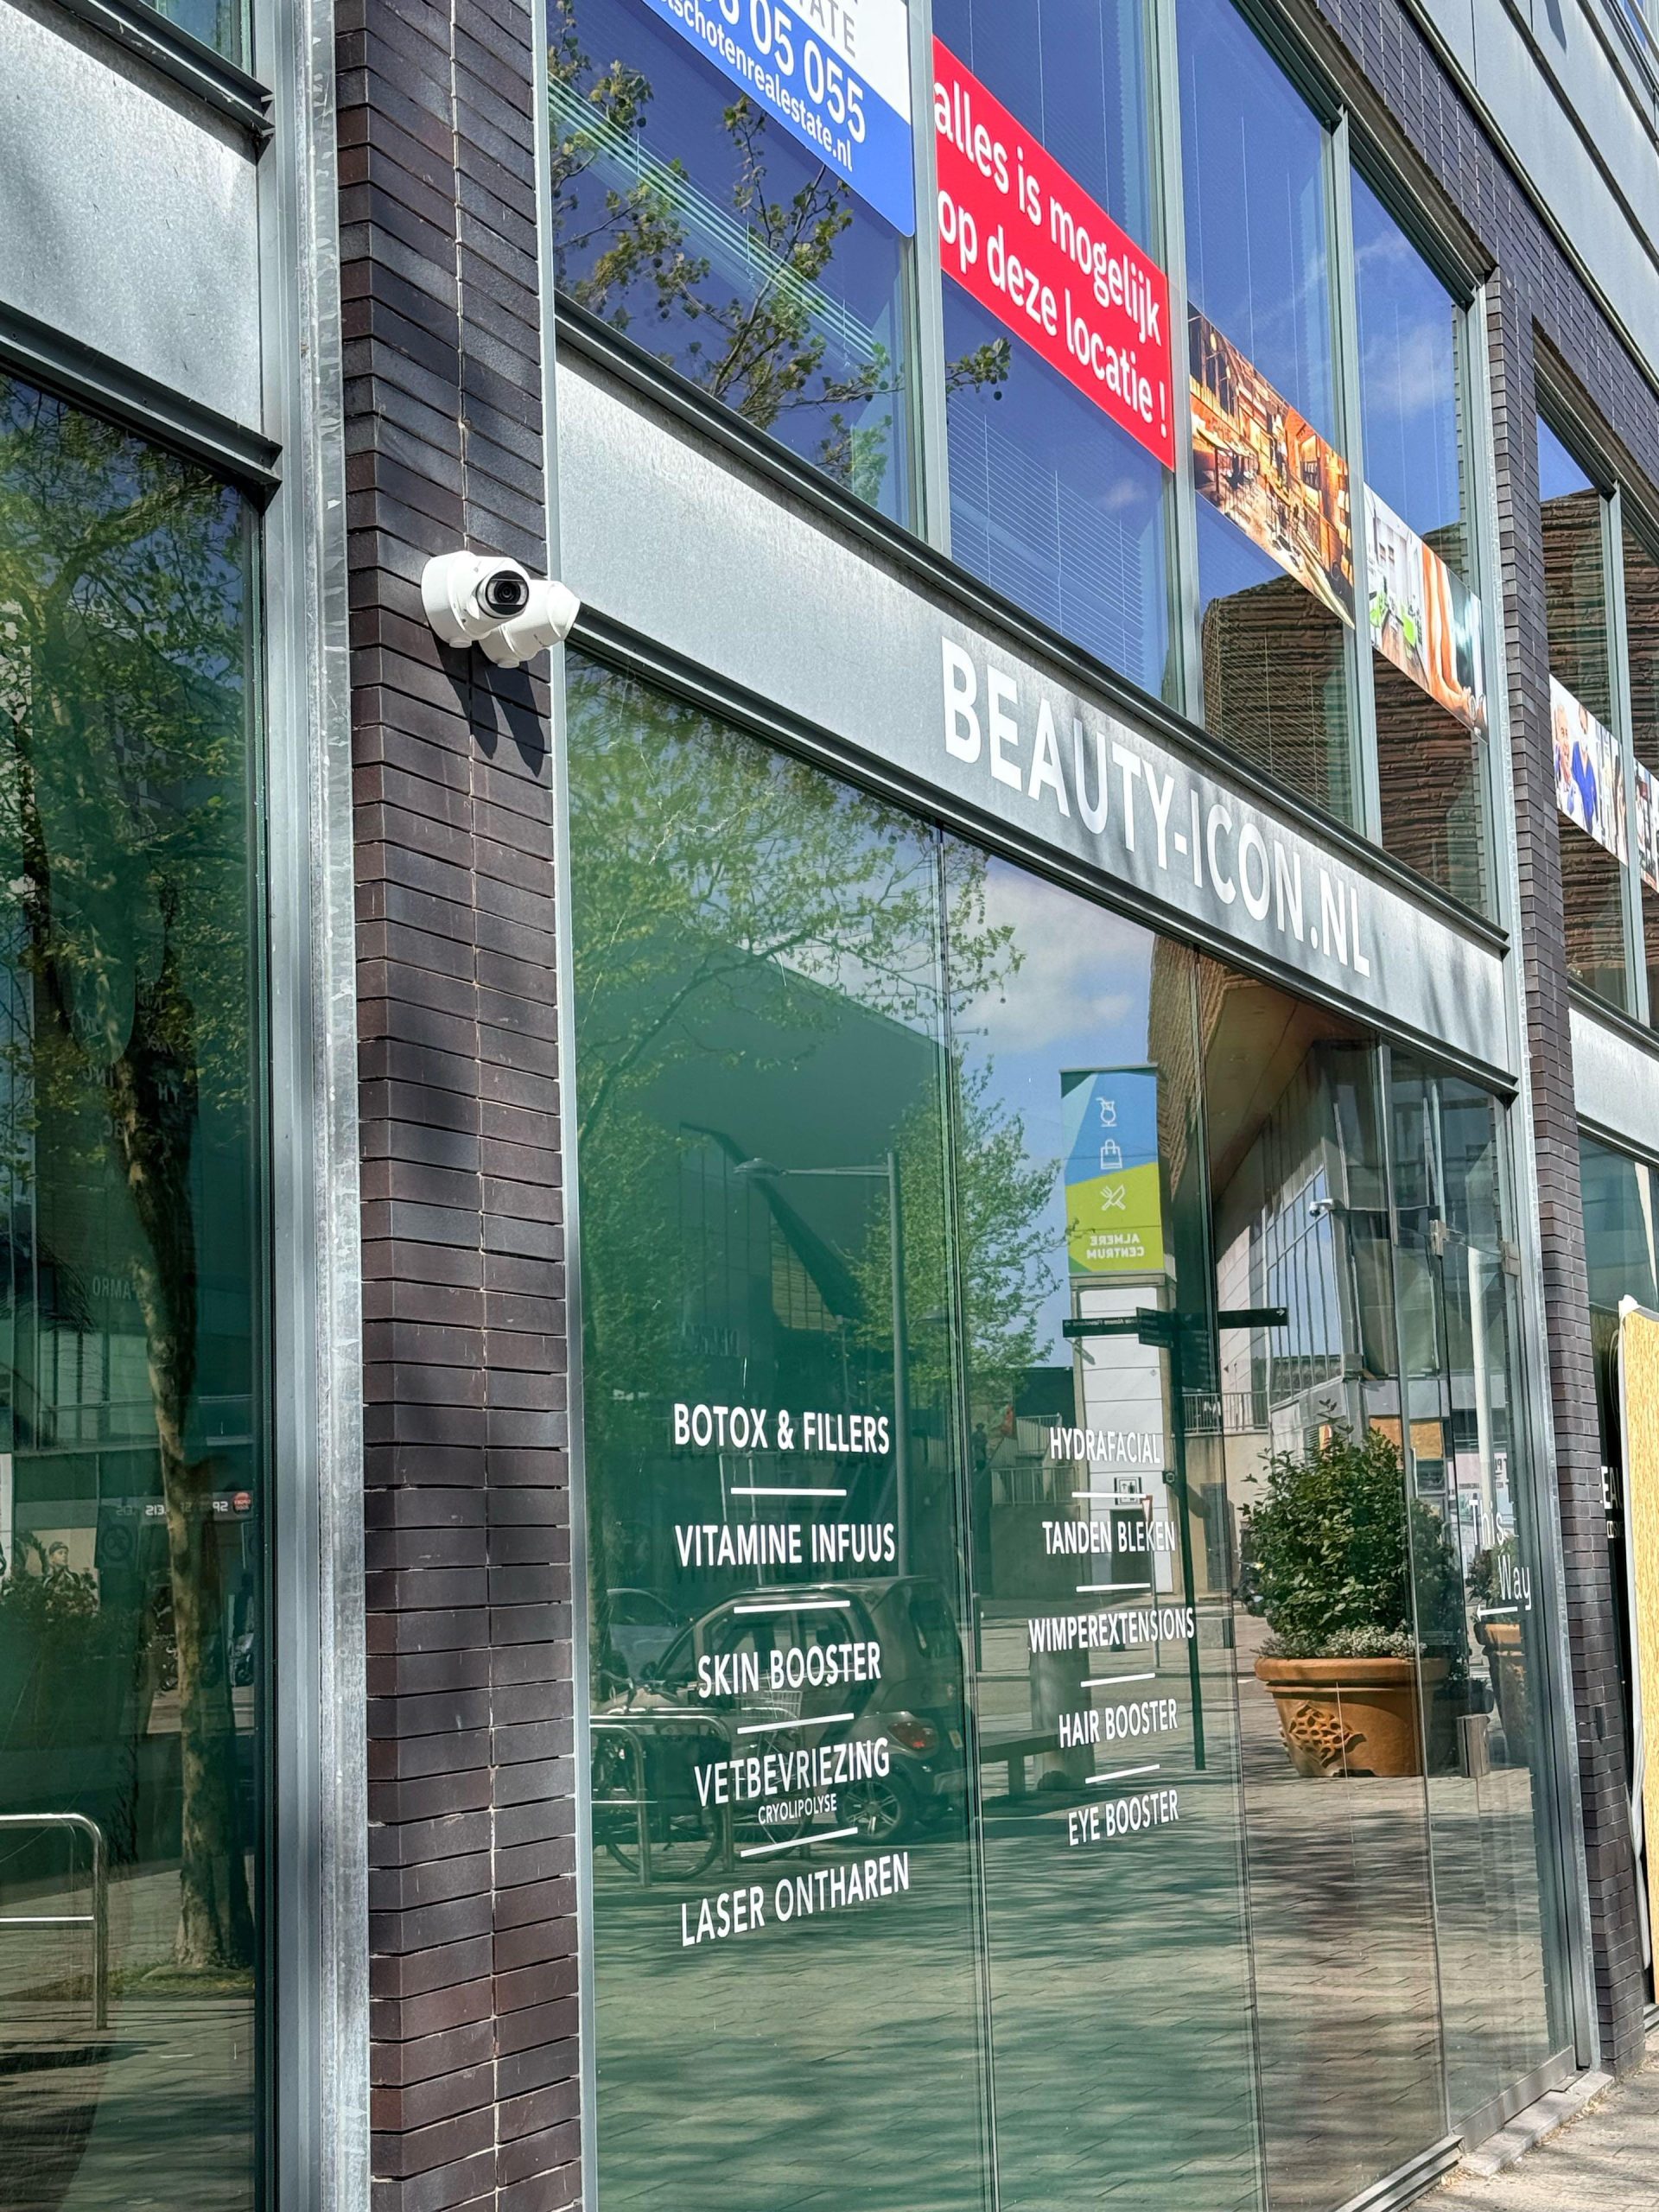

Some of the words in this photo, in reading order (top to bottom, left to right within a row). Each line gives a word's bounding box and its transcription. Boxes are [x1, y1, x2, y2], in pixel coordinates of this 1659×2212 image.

[660, 0, 853, 171] schotenrealestate.nl
[750, 0, 794, 76] 05
[804, 40, 866, 143] 055
[934, 81, 1009, 194] alles
[1018, 147, 1042, 226] is
[1051, 197, 1162, 346] mogelijk
[938, 194, 978, 273] op
[987, 226, 1058, 336] deze
[1065, 289, 1154, 423] locatie
[941, 636, 1370, 978] BEAUTY-ICON.NL
[674, 1403, 768, 1448] BOTOX
[778, 1409, 794, 1450] &
[803, 1412, 889, 1454] FILLERS
[1050, 1427, 1161, 1464] HYDRAFACIAL
[675, 1524, 802, 1567] VITAMINE
[812, 1523, 895, 1562] INFUUS
[1042, 1521, 1112, 1554] TANDEN
[1117, 1521, 1176, 1552] BLEKEN
[1469, 1499, 1505, 1546] This
[1498, 1554, 1531, 1611] Way
[1028, 1607, 1194, 1653] WIMPEREXTENSIONS
[698, 1652, 760, 1698] SKIN
[770, 1642, 881, 1690] BOOSTER
[1058, 1710, 1100, 1748] HAIR
[1105, 1698, 1178, 1740] BOOSTER
[694, 1738, 890, 1807] VETBEVRIEZING
[758, 1793, 837, 1825] CRYOLIPOLYSE
[1068, 1806, 1100, 1846] EYE
[1105, 1789, 1179, 1837] BOOSTER
[682, 1885, 766, 1947] LASER
[775, 1852, 909, 1922] ONTHAREN
